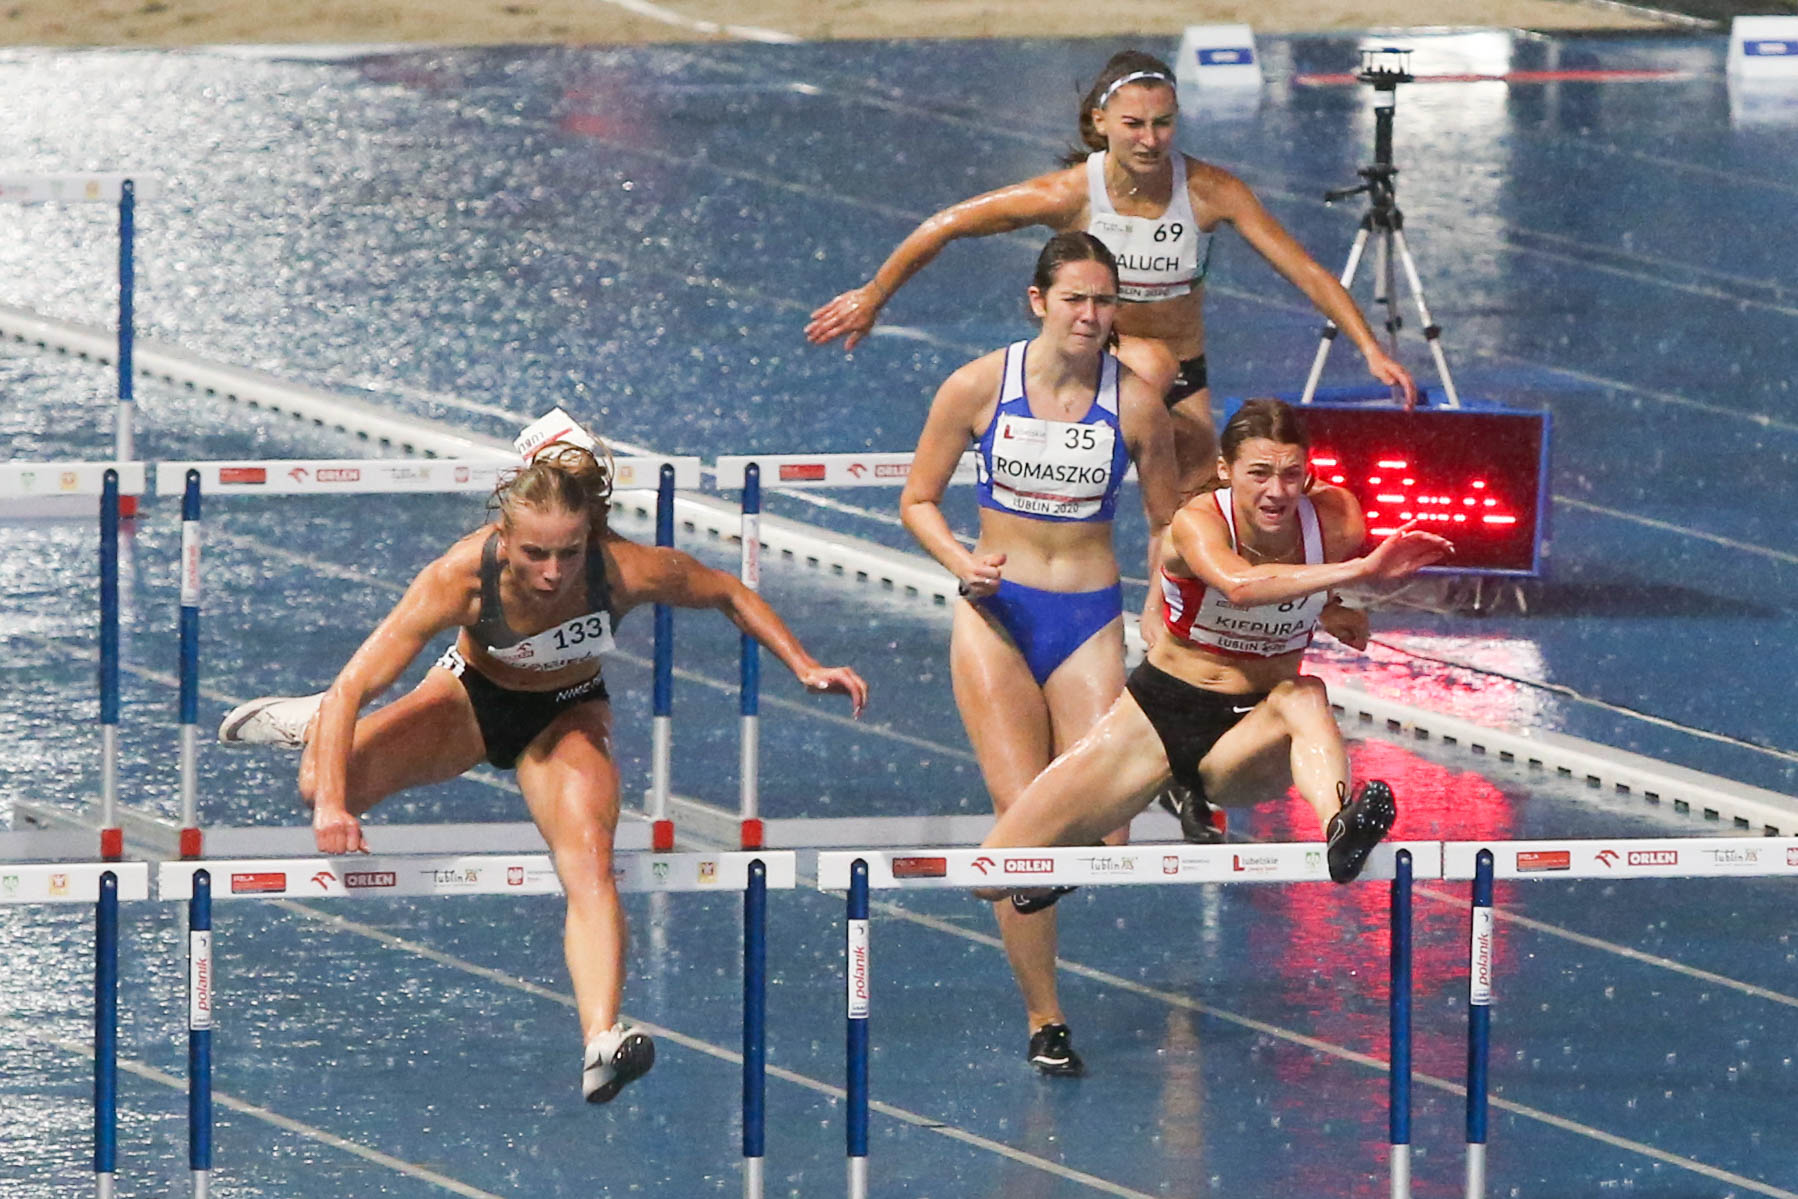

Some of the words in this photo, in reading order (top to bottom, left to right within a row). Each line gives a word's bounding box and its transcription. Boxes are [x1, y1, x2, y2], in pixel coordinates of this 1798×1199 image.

[1153, 223, 1184, 242] 69
[1065, 428, 1096, 450] 35
[997, 457, 1106, 484] ROMASZKO
[1013, 499, 1050, 513] LUBLIN
[1053, 503, 1079, 514] 2020
[553, 617, 603, 650] 133
[1216, 616, 1304, 636] KIEPURA
[1217, 637, 1258, 650] LUBLIN
[1006, 859, 1051, 872] ORLEN
[1630, 852, 1676, 864] ORLEN
[347, 873, 393, 886] ORLEN
[1476, 932, 1490, 986] polanik
[853, 945, 868, 999] polanik
[196, 958, 209, 1011] polanik
